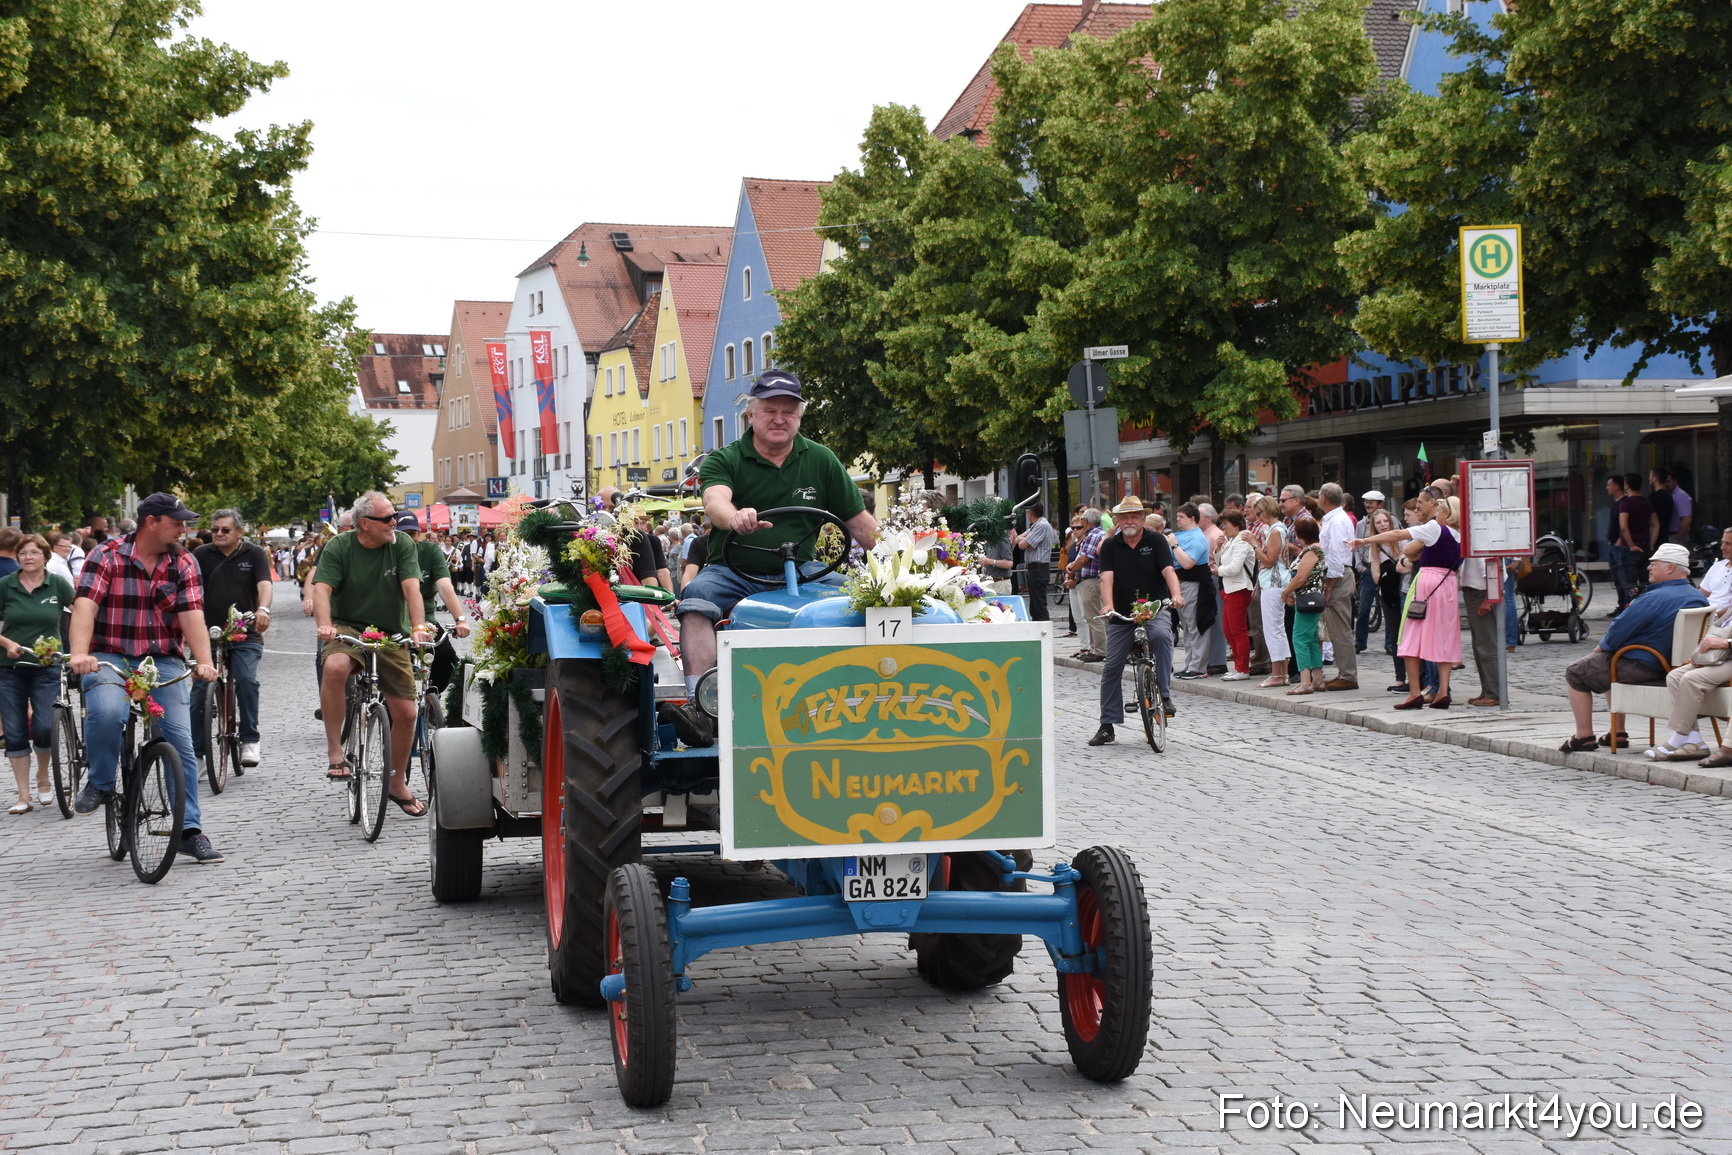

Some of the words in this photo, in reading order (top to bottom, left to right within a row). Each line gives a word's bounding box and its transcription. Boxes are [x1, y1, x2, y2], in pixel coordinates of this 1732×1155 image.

[1480, 244, 1502, 269] H
[1473, 283, 1510, 291] Marktplatz
[533, 335, 545, 364] K&L
[1092, 349, 1109, 357] Ulmer
[1109, 348, 1126, 356] Gasse
[612, 411, 627, 427] HOTEL
[878, 620, 901, 637] 17
[805, 682, 974, 733] EXPRESS
[859, 856, 886, 876] NM
[849, 878, 876, 898] GA
[883, 877, 921, 897] 824
